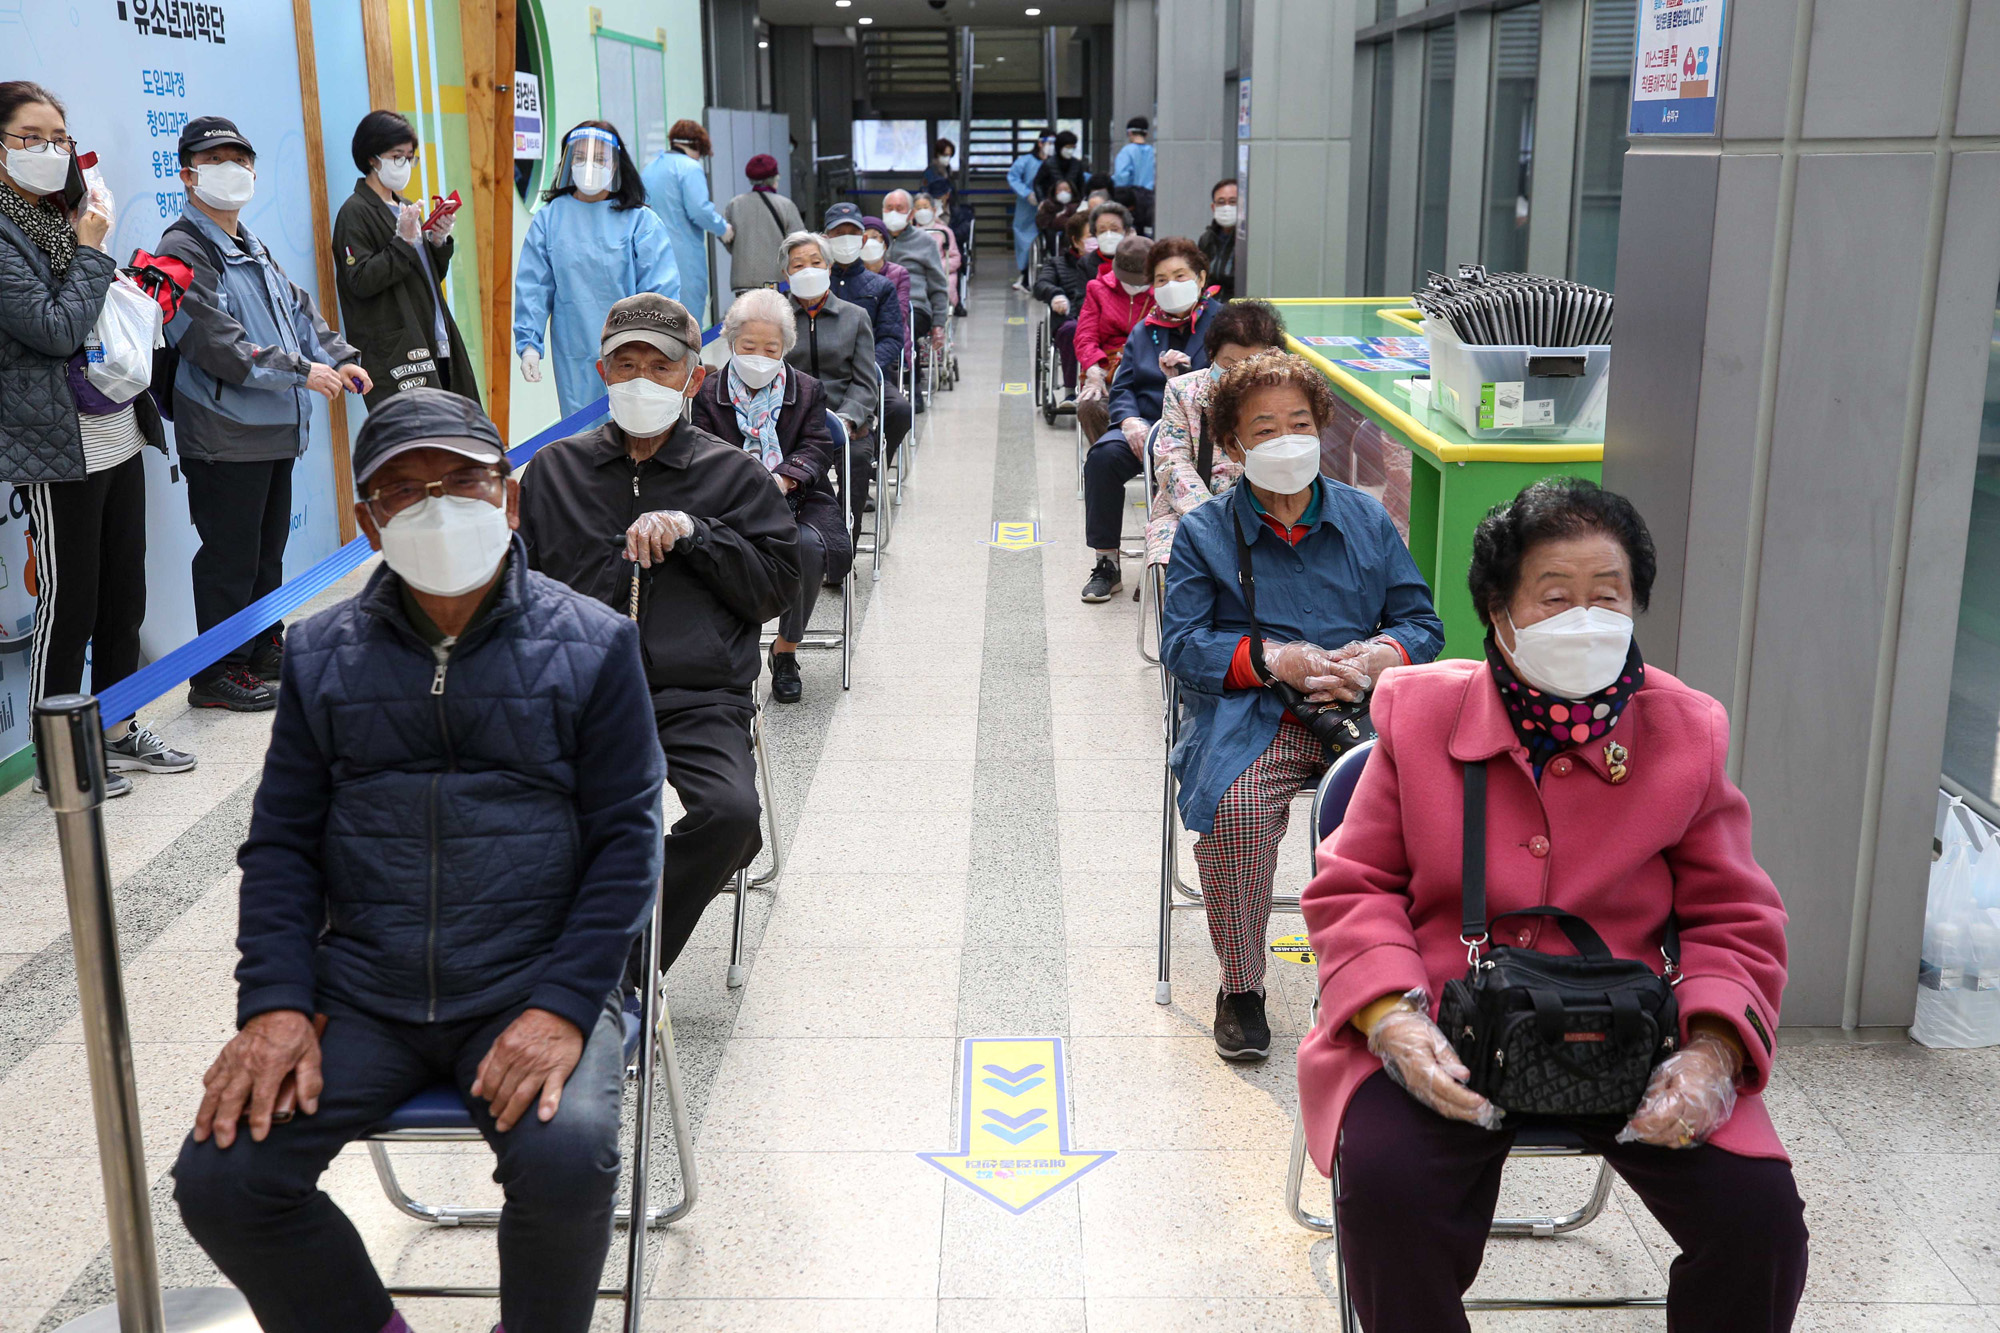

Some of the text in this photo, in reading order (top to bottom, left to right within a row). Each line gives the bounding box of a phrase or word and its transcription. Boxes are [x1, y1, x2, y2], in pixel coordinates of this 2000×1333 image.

[133, 0, 225, 44] 유소년과학단
[1645, 48, 1669, 68] 마스크를
[142, 69, 185, 97] 도입과정
[1642, 73, 1677, 93] 착용해주세요
[516, 80, 537, 111] 화장실
[156, 192, 187, 218] 영재과
[610, 309, 679, 329] TaylorMade
[410, 350, 428, 359] The
[966, 1159, 1066, 1168] 예방접종센터
